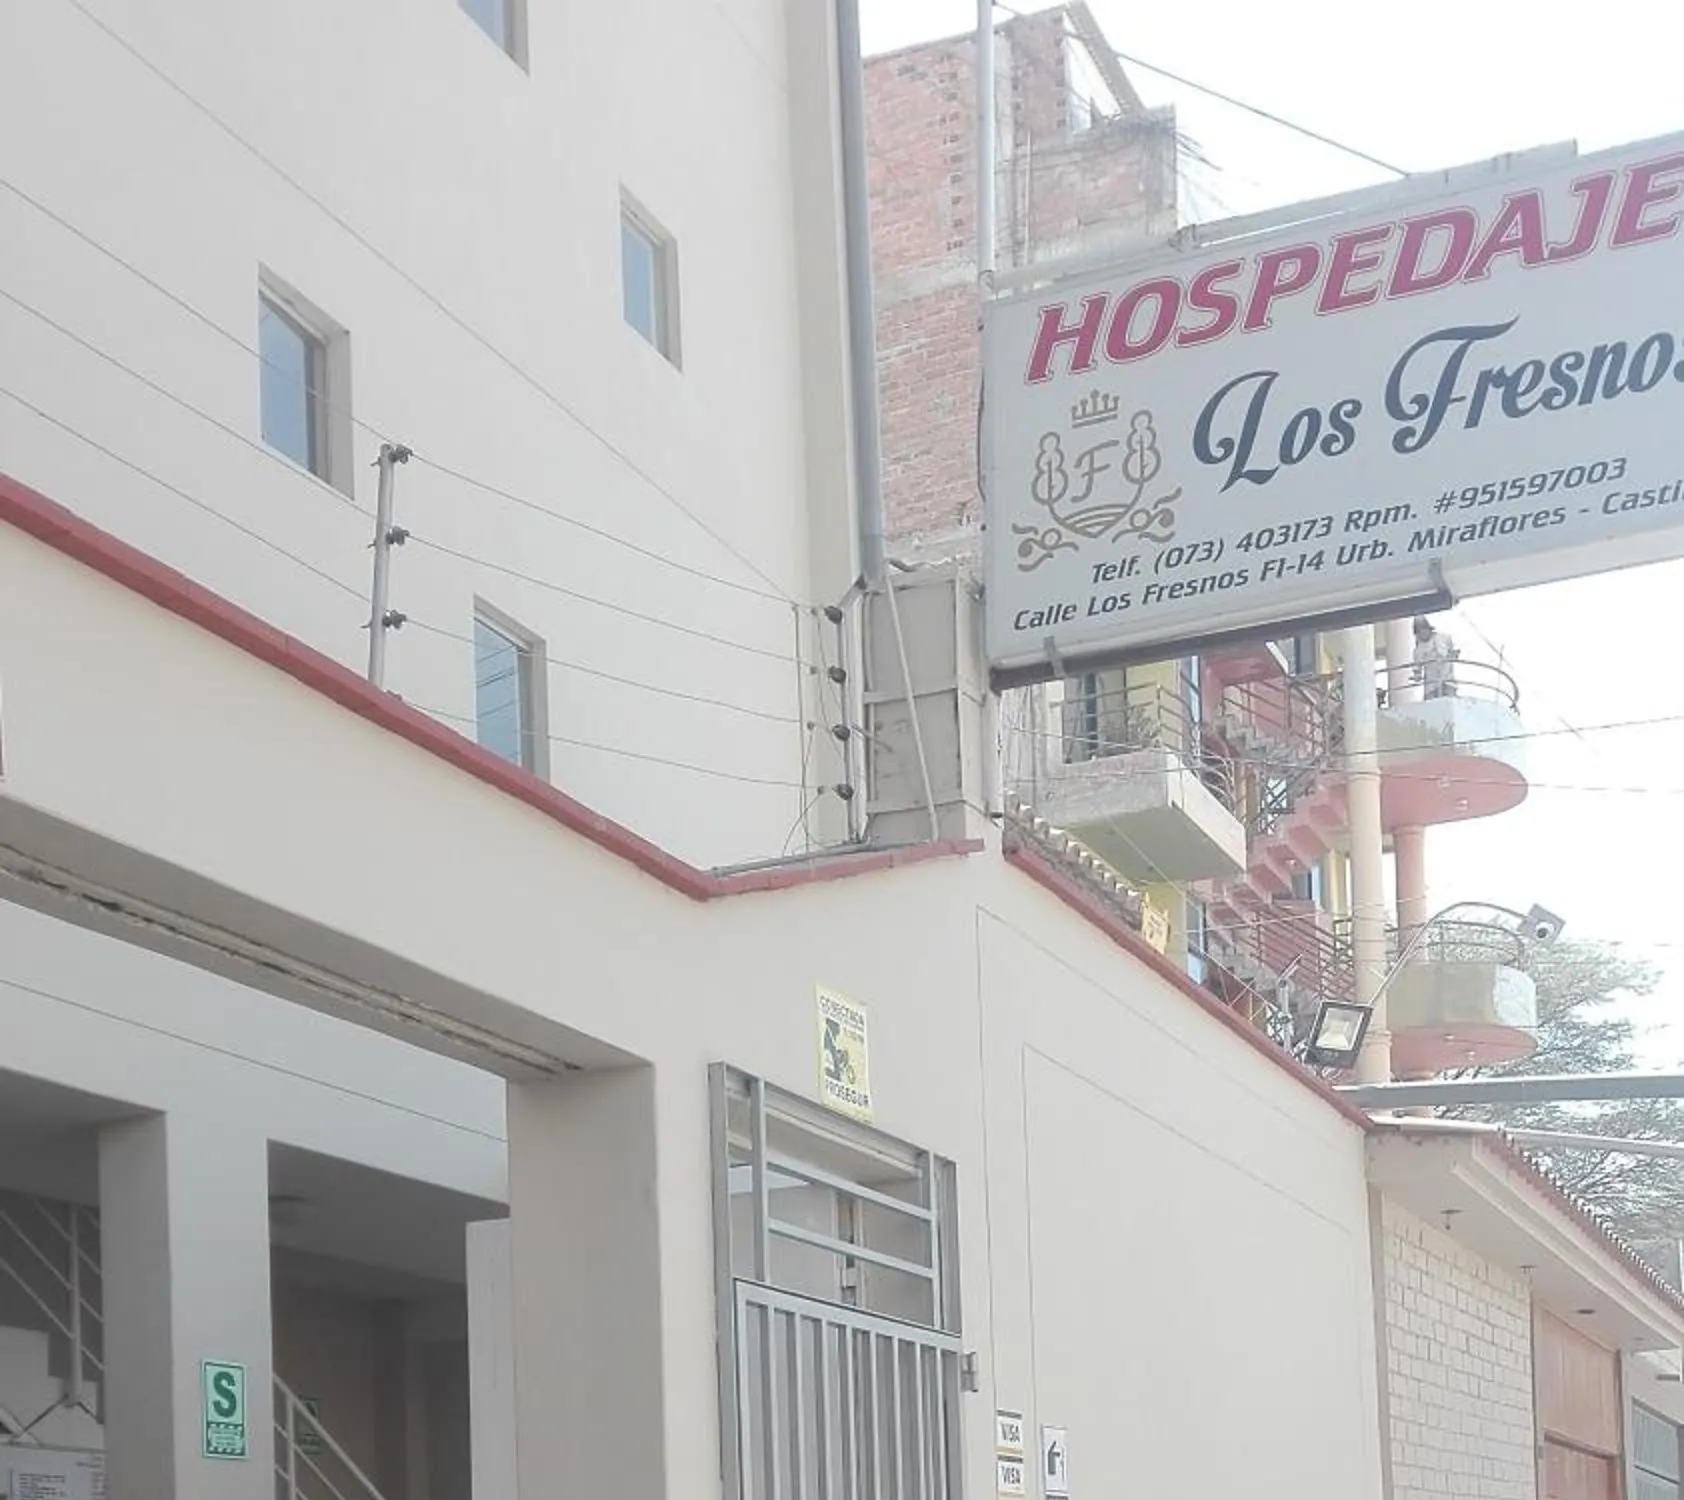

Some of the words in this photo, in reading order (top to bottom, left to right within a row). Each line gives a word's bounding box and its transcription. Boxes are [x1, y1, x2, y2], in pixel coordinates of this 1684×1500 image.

[1024, 152, 1684, 384] HOSPEDAJE
[1071, 440, 1120, 503] F
[1192, 371, 1362, 492] Los
[1091, 556, 1141, 584] Telf.
[1153, 537, 1225, 575] (073)
[1235, 515, 1334, 552] 403173
[1343, 503, 1417, 532] Rpm.
[1434, 457, 1627, 513] #951597003
[1013, 602, 1077, 631] Calle
[1087, 593, 1131, 617] Los
[1142, 568, 1249, 605] Fresnos
[1335, 538, 1393, 565] Urb.
[1407, 506, 1567, 552] Miraflores
[213, 1371, 237, 1418] S
[1001, 1423, 1021, 1443] VISA
[1001, 1465, 1021, 1485] VISA
